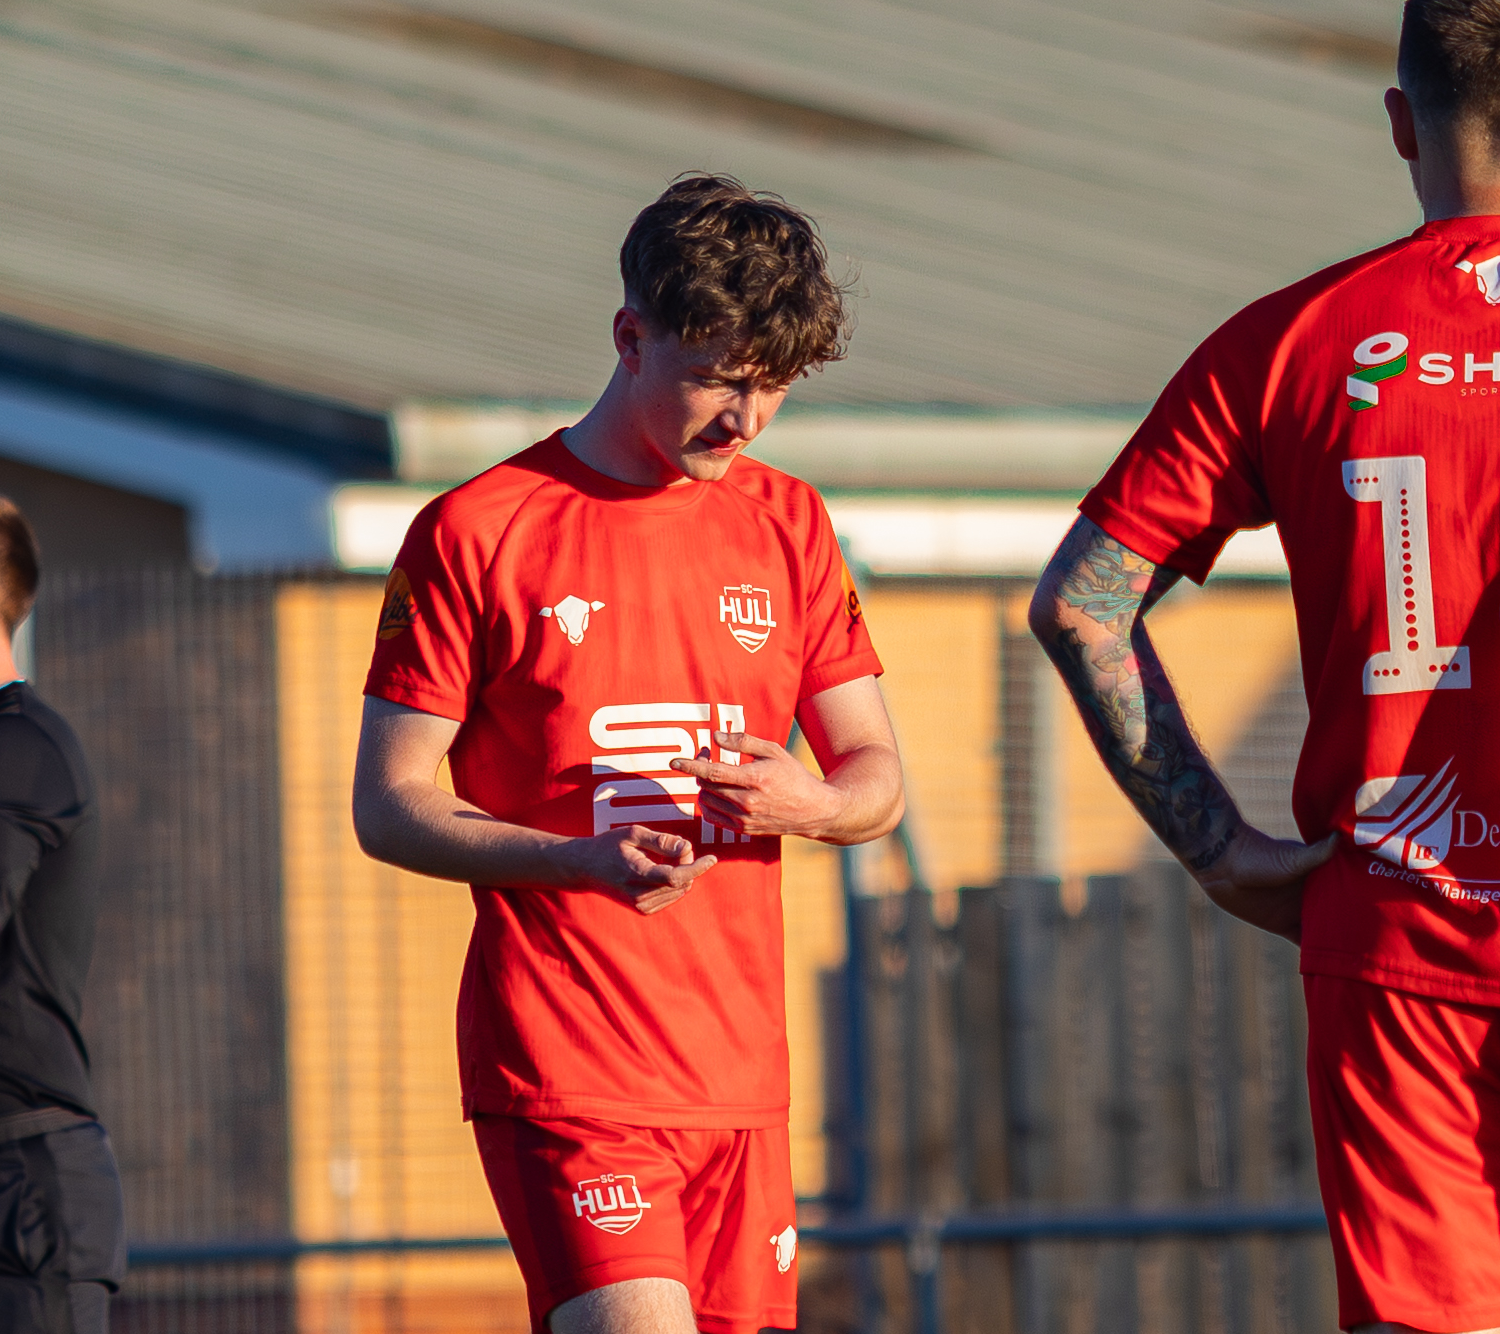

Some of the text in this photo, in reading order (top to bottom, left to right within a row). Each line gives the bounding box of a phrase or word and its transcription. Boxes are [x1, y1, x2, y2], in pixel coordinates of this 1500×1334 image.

[740, 583, 753, 594] SC
[718, 595, 777, 627] HULL
[600, 1173, 615, 1184] SC
[572, 1185, 651, 1217] HULL
